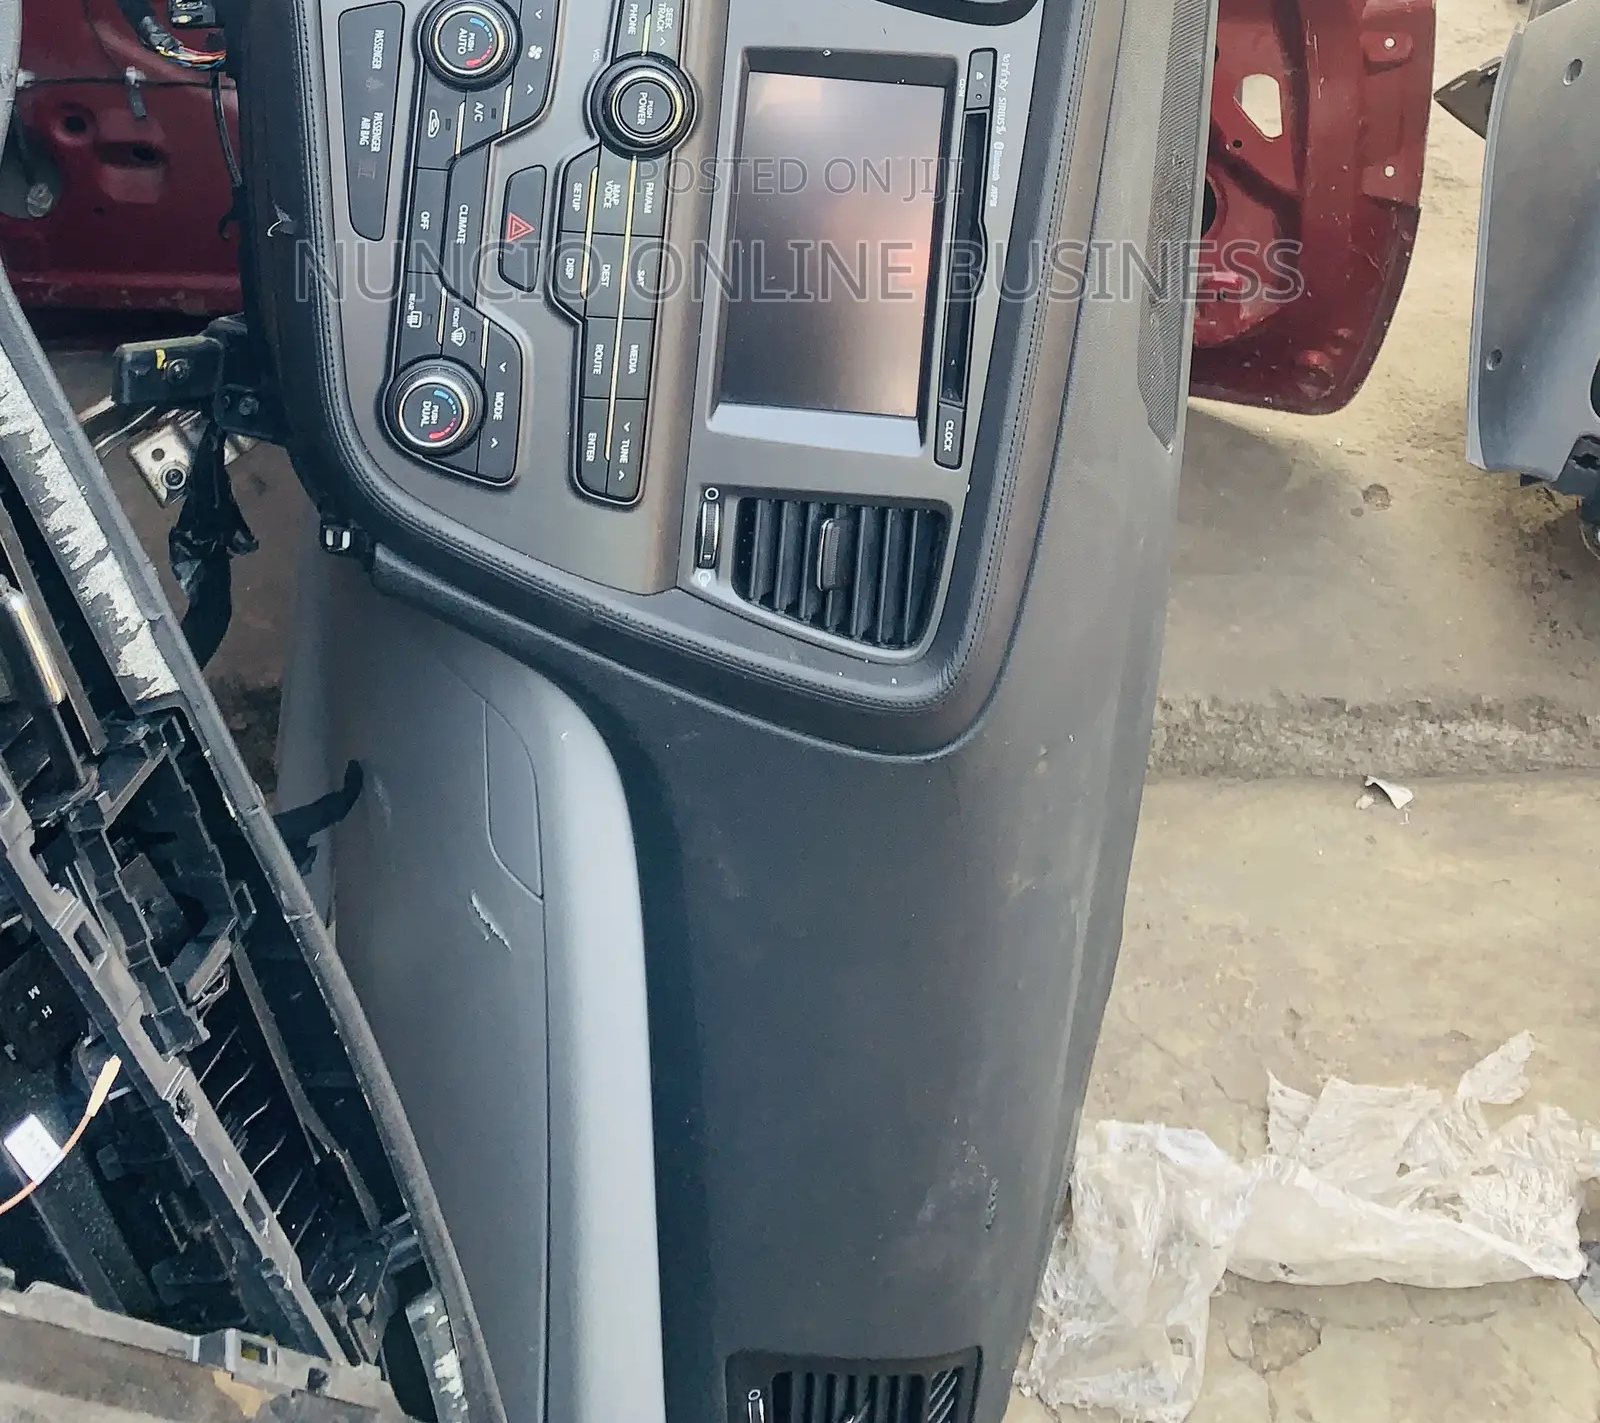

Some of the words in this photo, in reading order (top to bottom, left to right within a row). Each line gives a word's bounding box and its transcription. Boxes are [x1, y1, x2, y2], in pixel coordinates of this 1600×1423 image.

[627, 3, 639, 36] PHONE
[656, 3, 667, 33] TRACK
[664, 6, 674, 30] SEEK
[371, 29, 384, 70] PASSENGER
[457, 28, 468, 55] AUTO
[467, 32, 476, 52] PUSH
[592, 48, 600, 63] VOL
[473, 102, 484, 122] A/C
[637, 92, 648, 126] POWER
[645, 100, 654, 119] PUSH
[371, 111, 384, 153] PASSENGER
[572, 182, 583, 212] SETUP
[603, 180, 614, 209] VOICE
[611, 184, 621, 206] MAP
[643, 182, 655, 214] FM/AM
[420, 210, 431, 231] OFF
[456, 204, 469, 246] CLIMATE
[565, 258, 575, 280] DISP
[600, 263, 611, 288] DEST
[636, 270, 646, 288] SAT
[408, 293, 416, 312] REAR
[452, 307, 460, 329] FRONT
[593, 344, 604, 376] ROUTE
[627, 344, 639, 375] MEDIA
[420, 401, 433, 428] DUAL
[430, 405, 440, 425] PUSH
[493, 391, 505, 421] MODE
[585, 432, 597, 463] ENTER
[943, 419, 955, 452] CLOCK
[619, 438, 630, 465] TUNE
